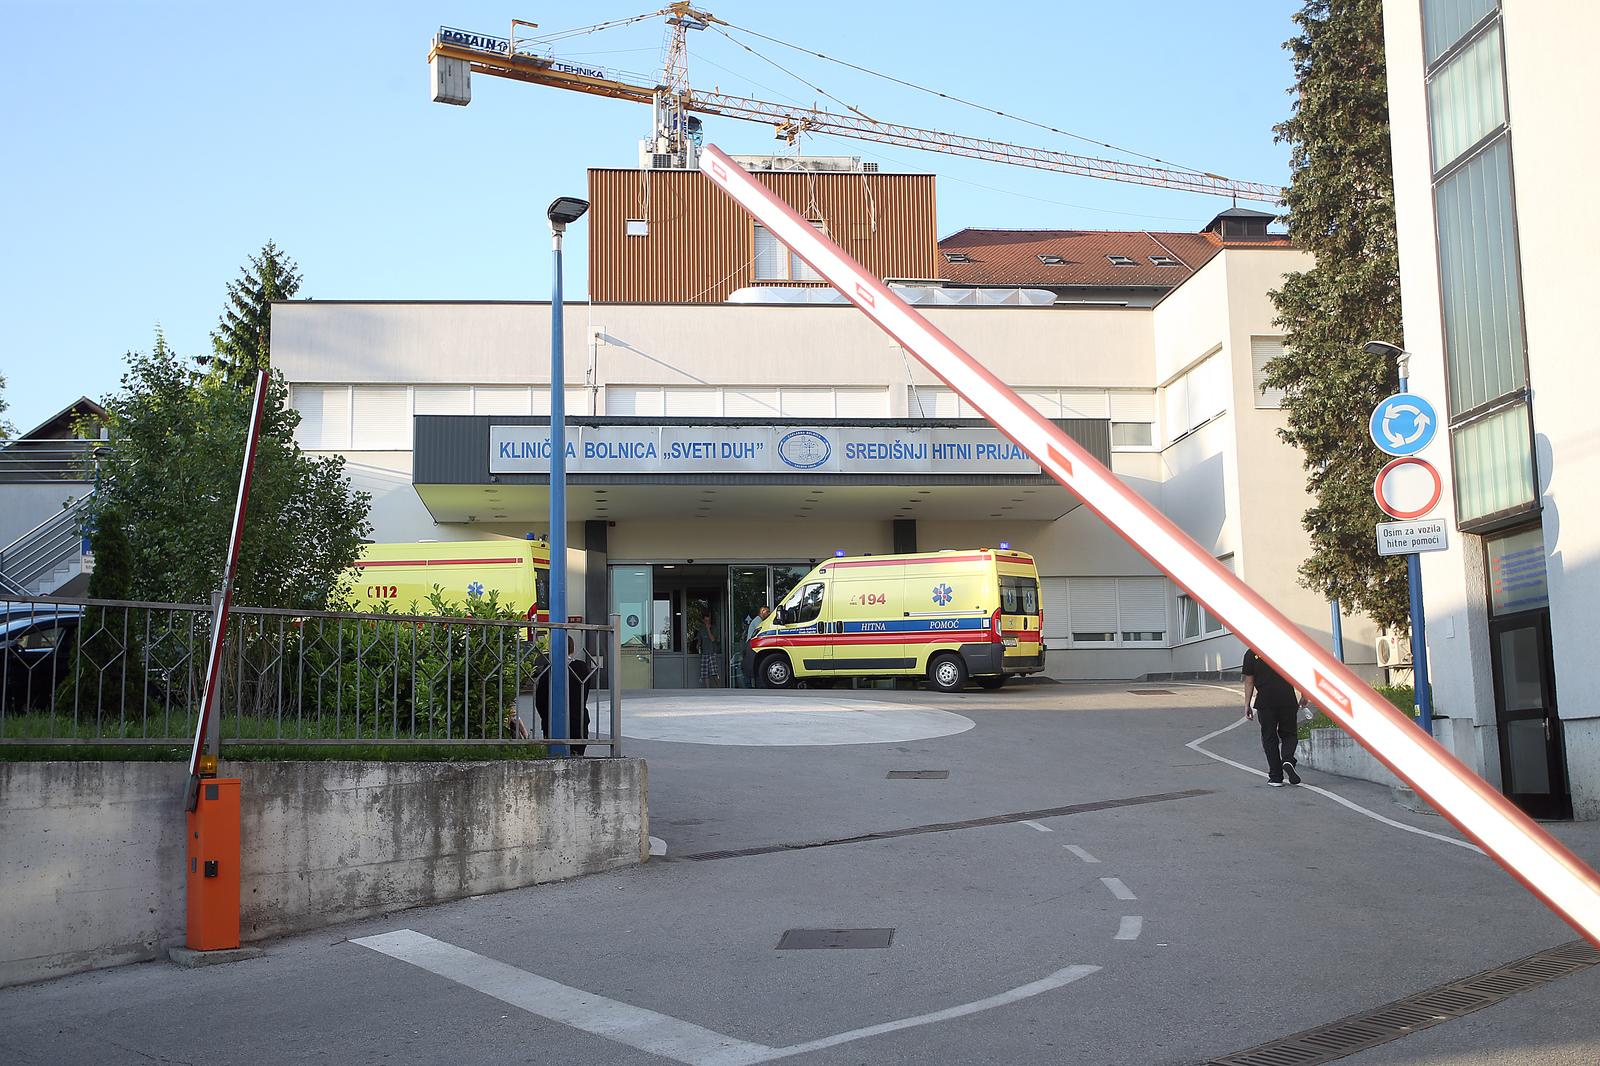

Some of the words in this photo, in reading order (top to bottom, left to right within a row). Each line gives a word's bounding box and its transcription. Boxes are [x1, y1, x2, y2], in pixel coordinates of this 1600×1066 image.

[442, 29, 497, 49] POTAIN
[555, 62, 604, 79] TEHNIKA
[499, 438, 577, 459] KLINIČA
[584, 441, 657, 459] BOLNICA
[845, 439, 928, 460] SREDIŠNJI
[932, 443, 972, 460] HITNI
[1383, 528, 1403, 538] Osim
[1405, 528, 1414, 536] za
[1418, 524, 1441, 534] vozila
[1386, 539, 1408, 548] hitne
[1411, 535, 1440, 547] pomoći
[375, 585, 398, 598] 112
[859, 593, 886, 606] 194
[861, 622, 886, 631] HITNA
[929, 618, 960, 629] POMOĆ
